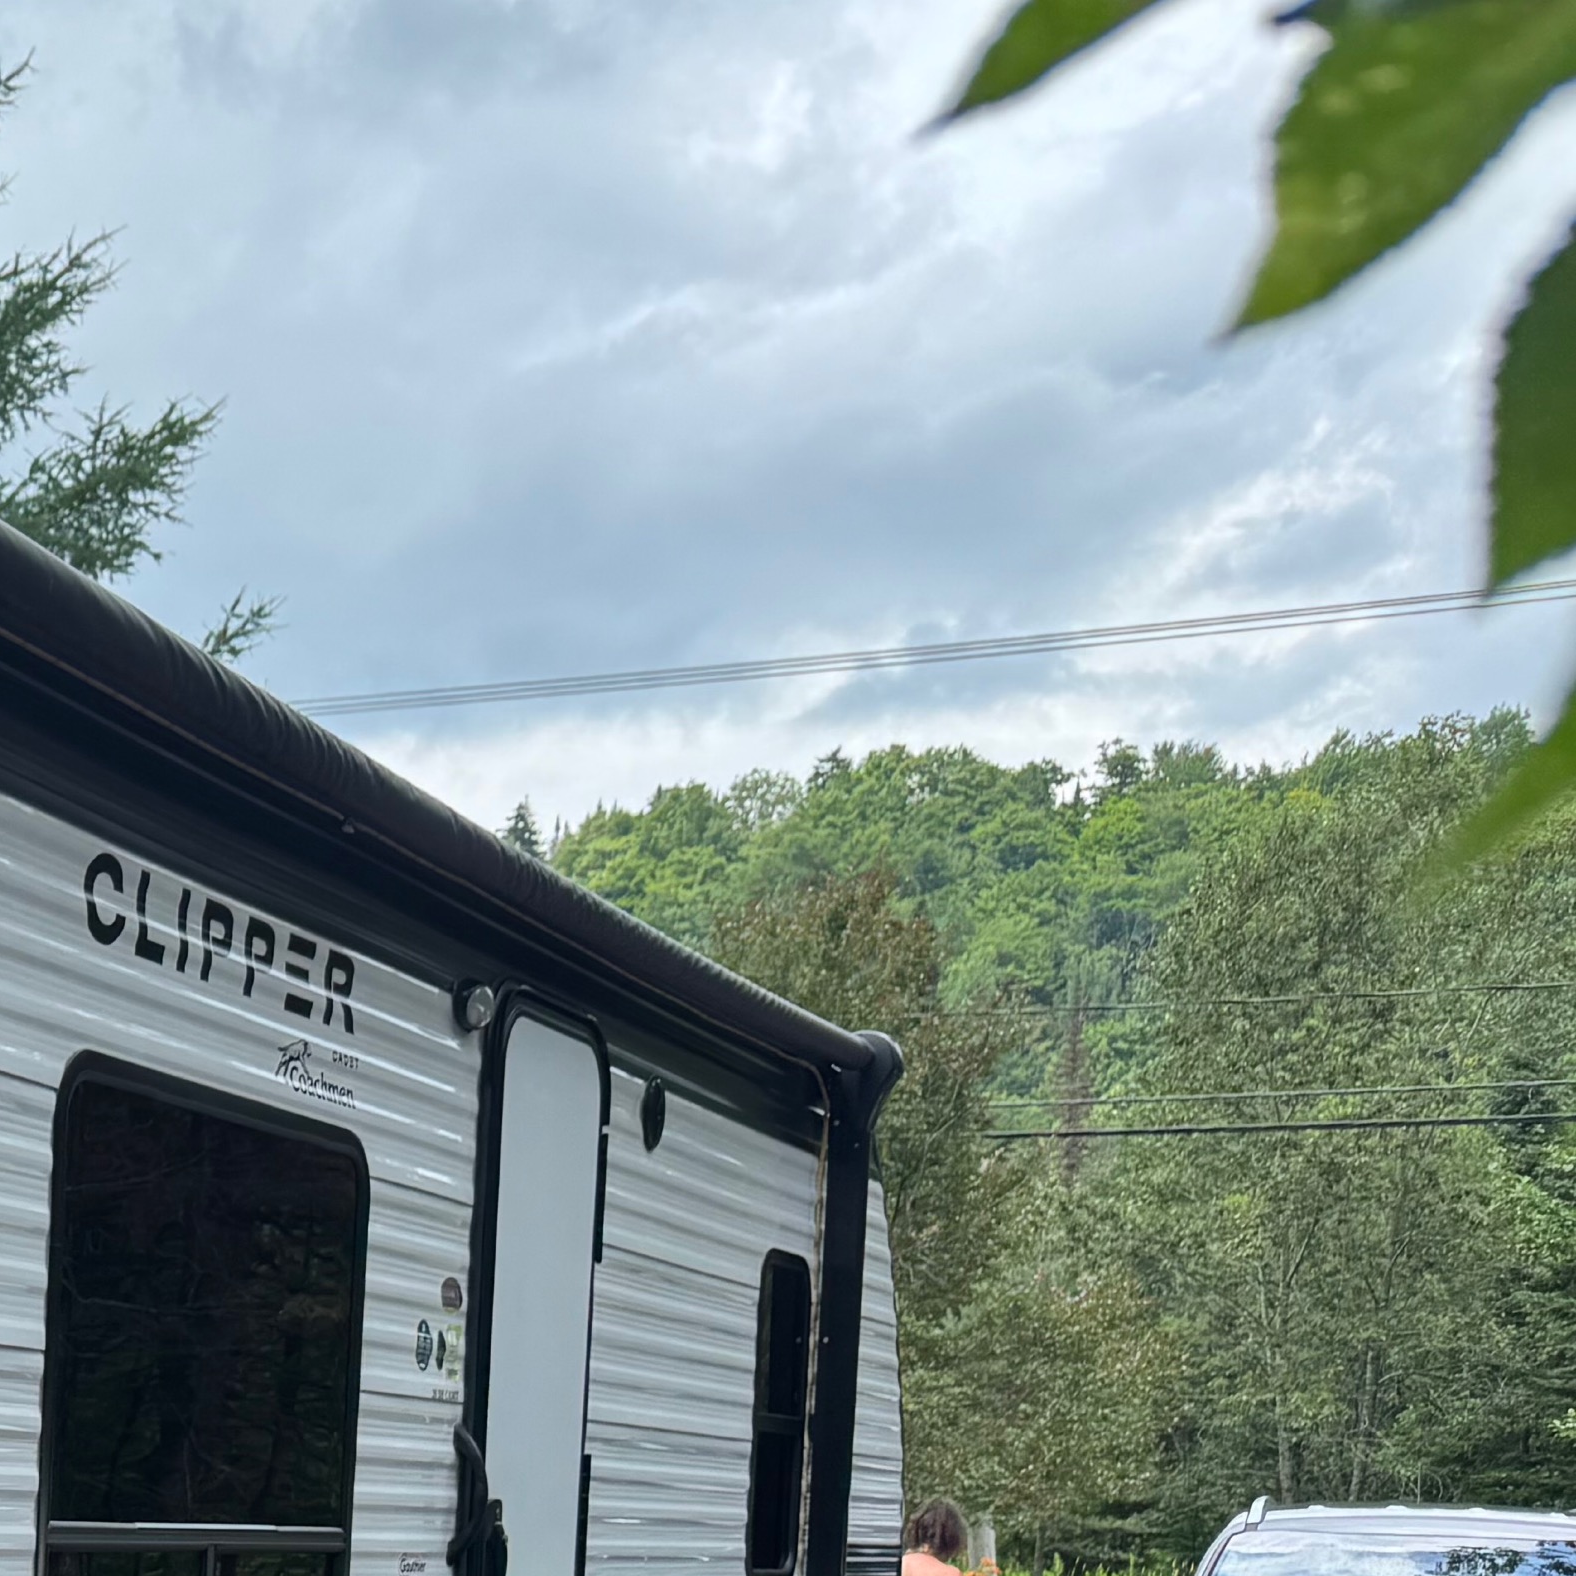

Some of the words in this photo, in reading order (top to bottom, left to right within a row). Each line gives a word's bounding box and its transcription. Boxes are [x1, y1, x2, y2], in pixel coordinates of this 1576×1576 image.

[83, 853, 356, 1035] CLIPPER
[332, 1051, 360, 1069] CADET
[290, 1066, 357, 1109] Coachmen
